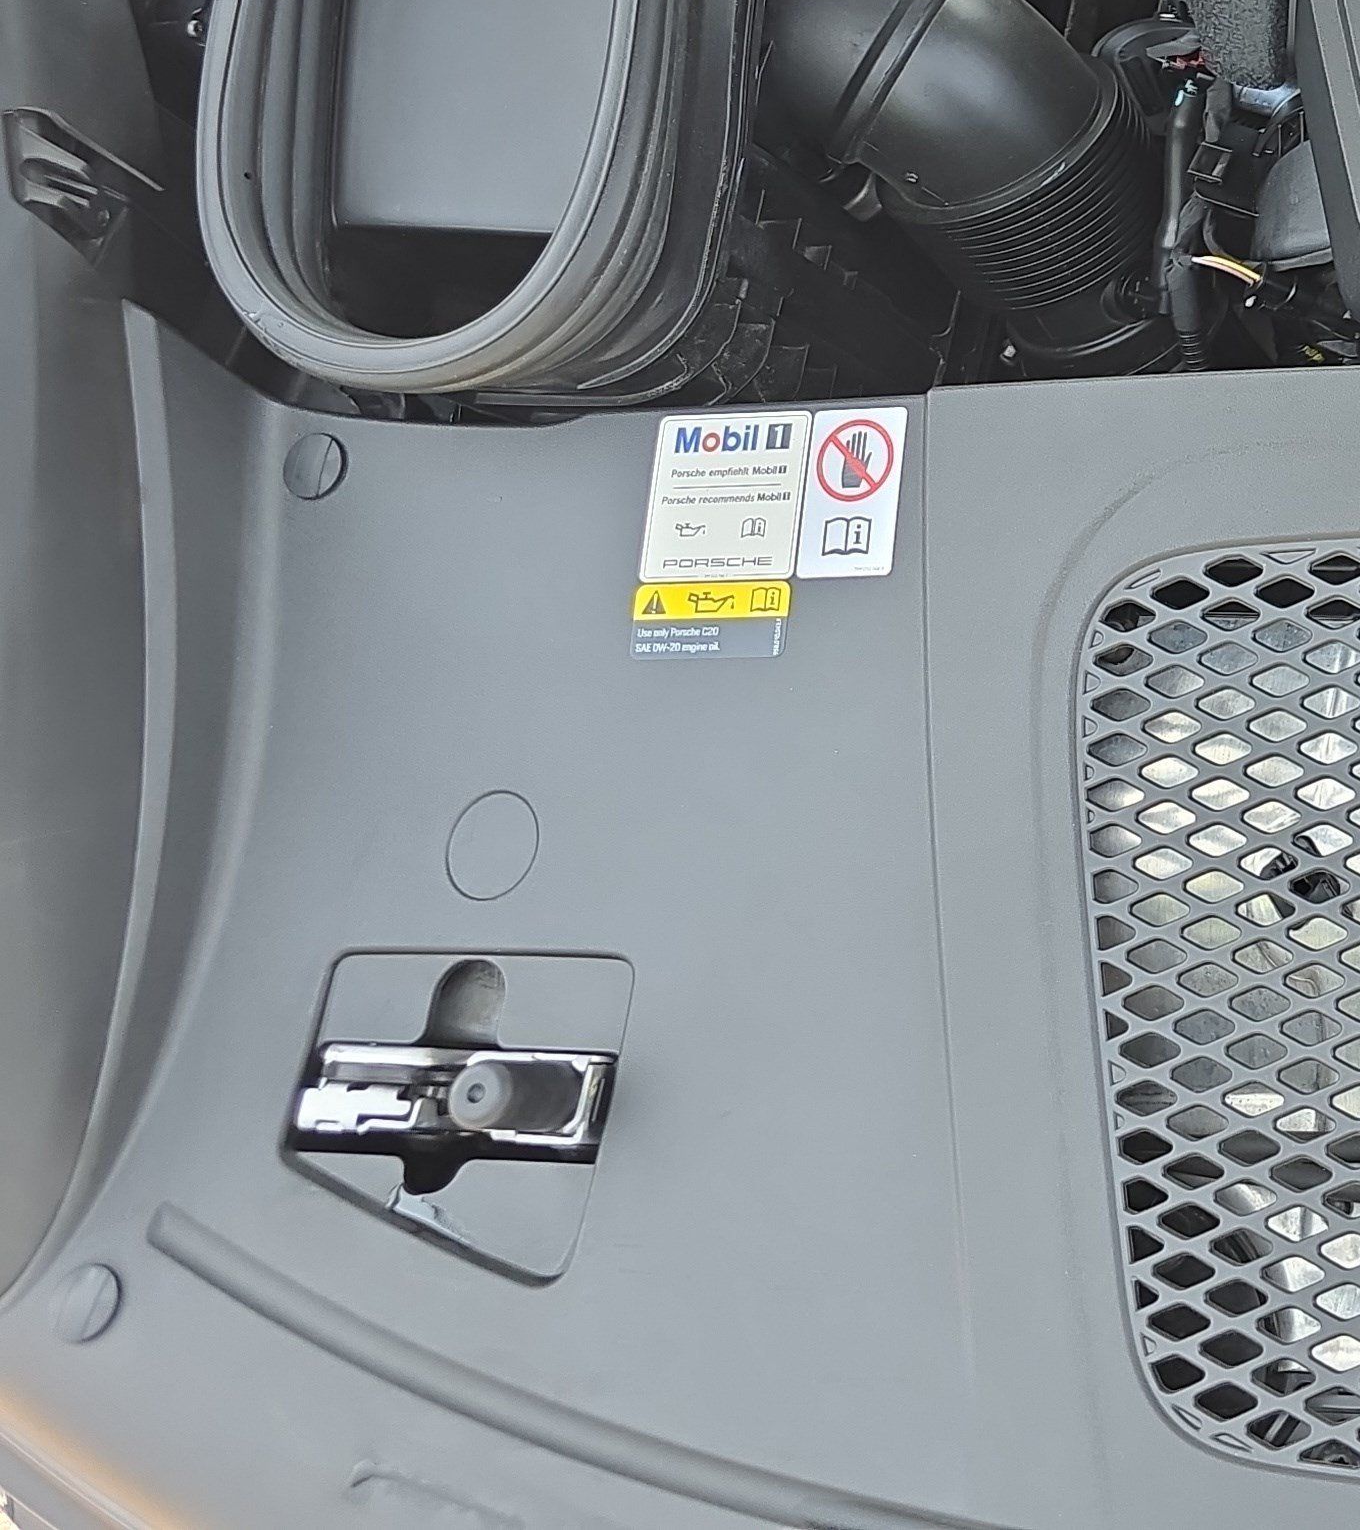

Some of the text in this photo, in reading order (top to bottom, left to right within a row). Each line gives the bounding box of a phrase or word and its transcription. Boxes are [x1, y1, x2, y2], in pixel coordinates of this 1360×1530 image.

[674, 424, 759, 454] Mobil
[671, 468, 706, 478] Porsche
[709, 466, 749, 478] empfiehlt
[752, 465, 777, 475] Mobil
[661, 495, 696, 505] Porsche
[698, 494, 755, 504] recommends
[757, 492, 781, 502] Mobil
[663, 556, 773, 569] PORSCHE
[637, 628, 653, 637] Use
[653, 628, 669, 640] only
[670, 627, 700, 638] Porsche
[635, 643, 652, 653] SAE
